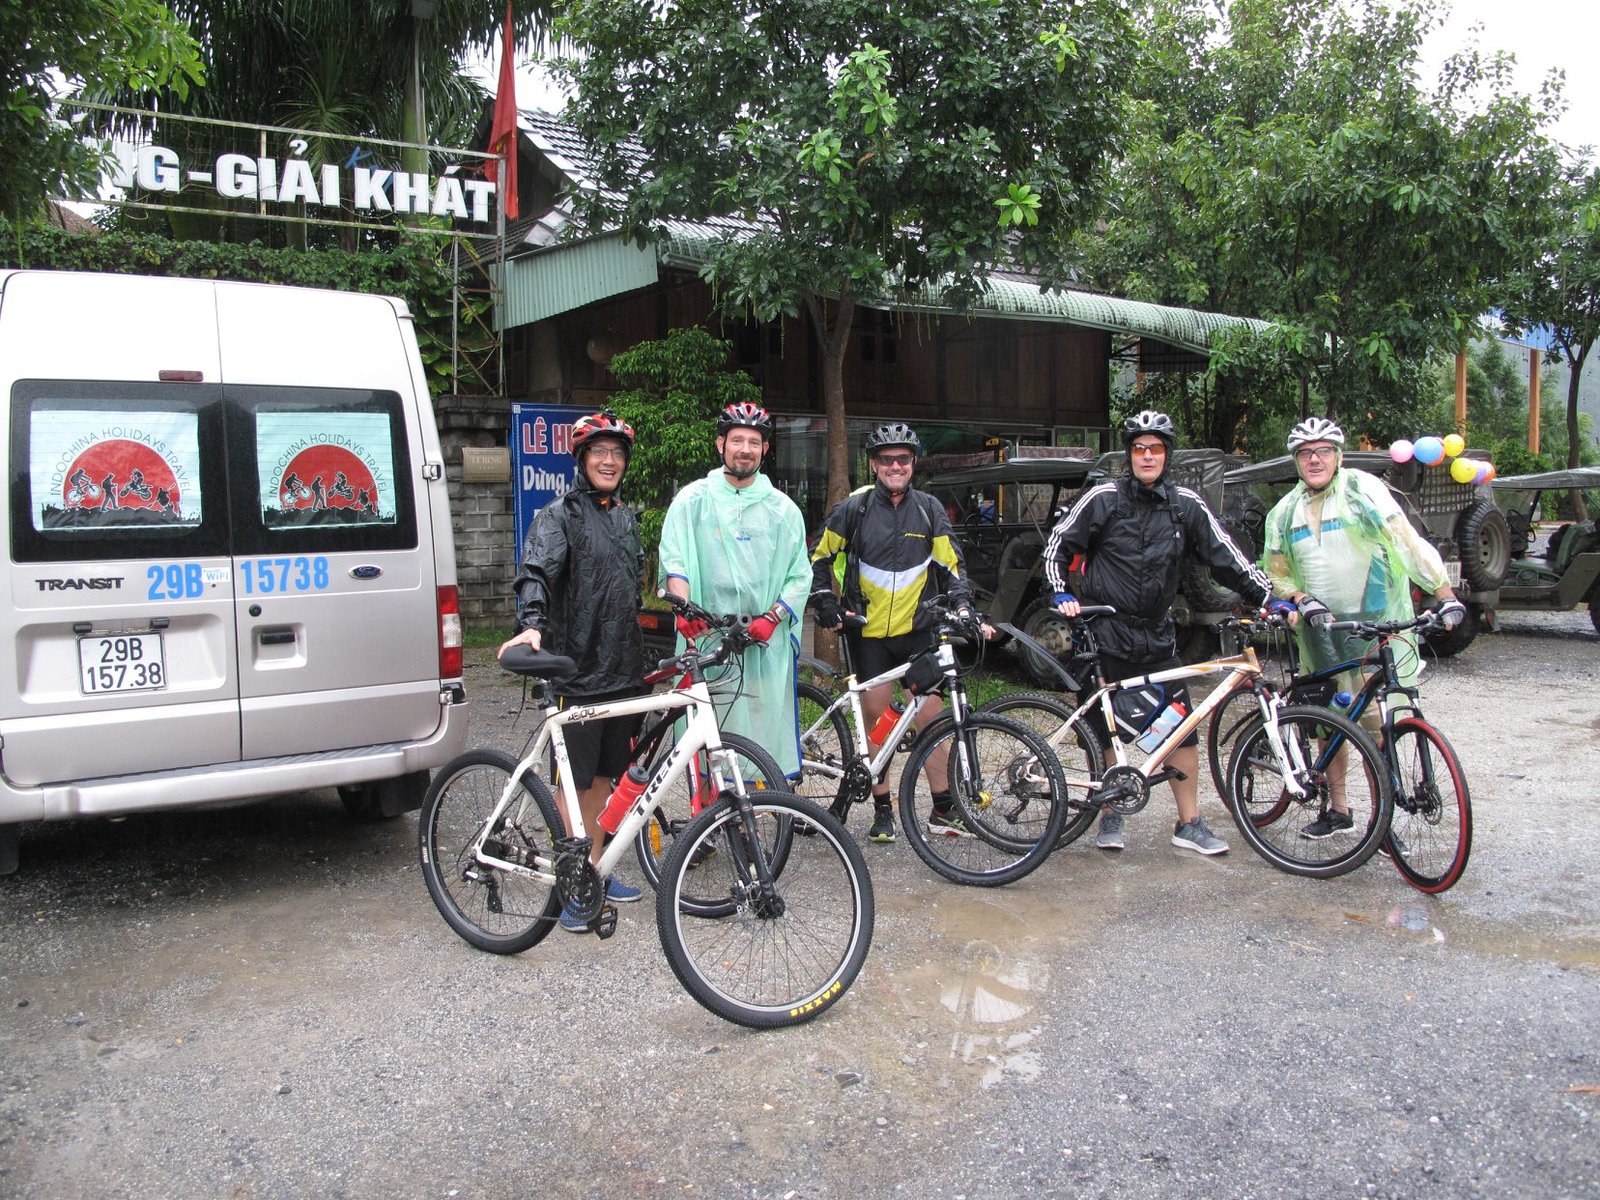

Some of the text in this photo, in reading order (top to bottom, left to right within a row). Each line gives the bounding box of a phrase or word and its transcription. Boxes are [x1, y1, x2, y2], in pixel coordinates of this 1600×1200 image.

[354, 165, 496, 224] KHÁT
[523, 416, 548, 455] LÊ
[50, 427, 191, 496] INDOCHINA HOLIDAYS TRAVEL
[269, 433, 388, 498] INDOCHINA HOLIDAYS TRAVEL
[35, 577, 125, 591] TRANSIT
[147, 556, 329, 600] 29B 15738
[100, 637, 144, 663] 29B
[87, 662, 162, 690] 157.38
[632, 747, 681, 817] TREK
